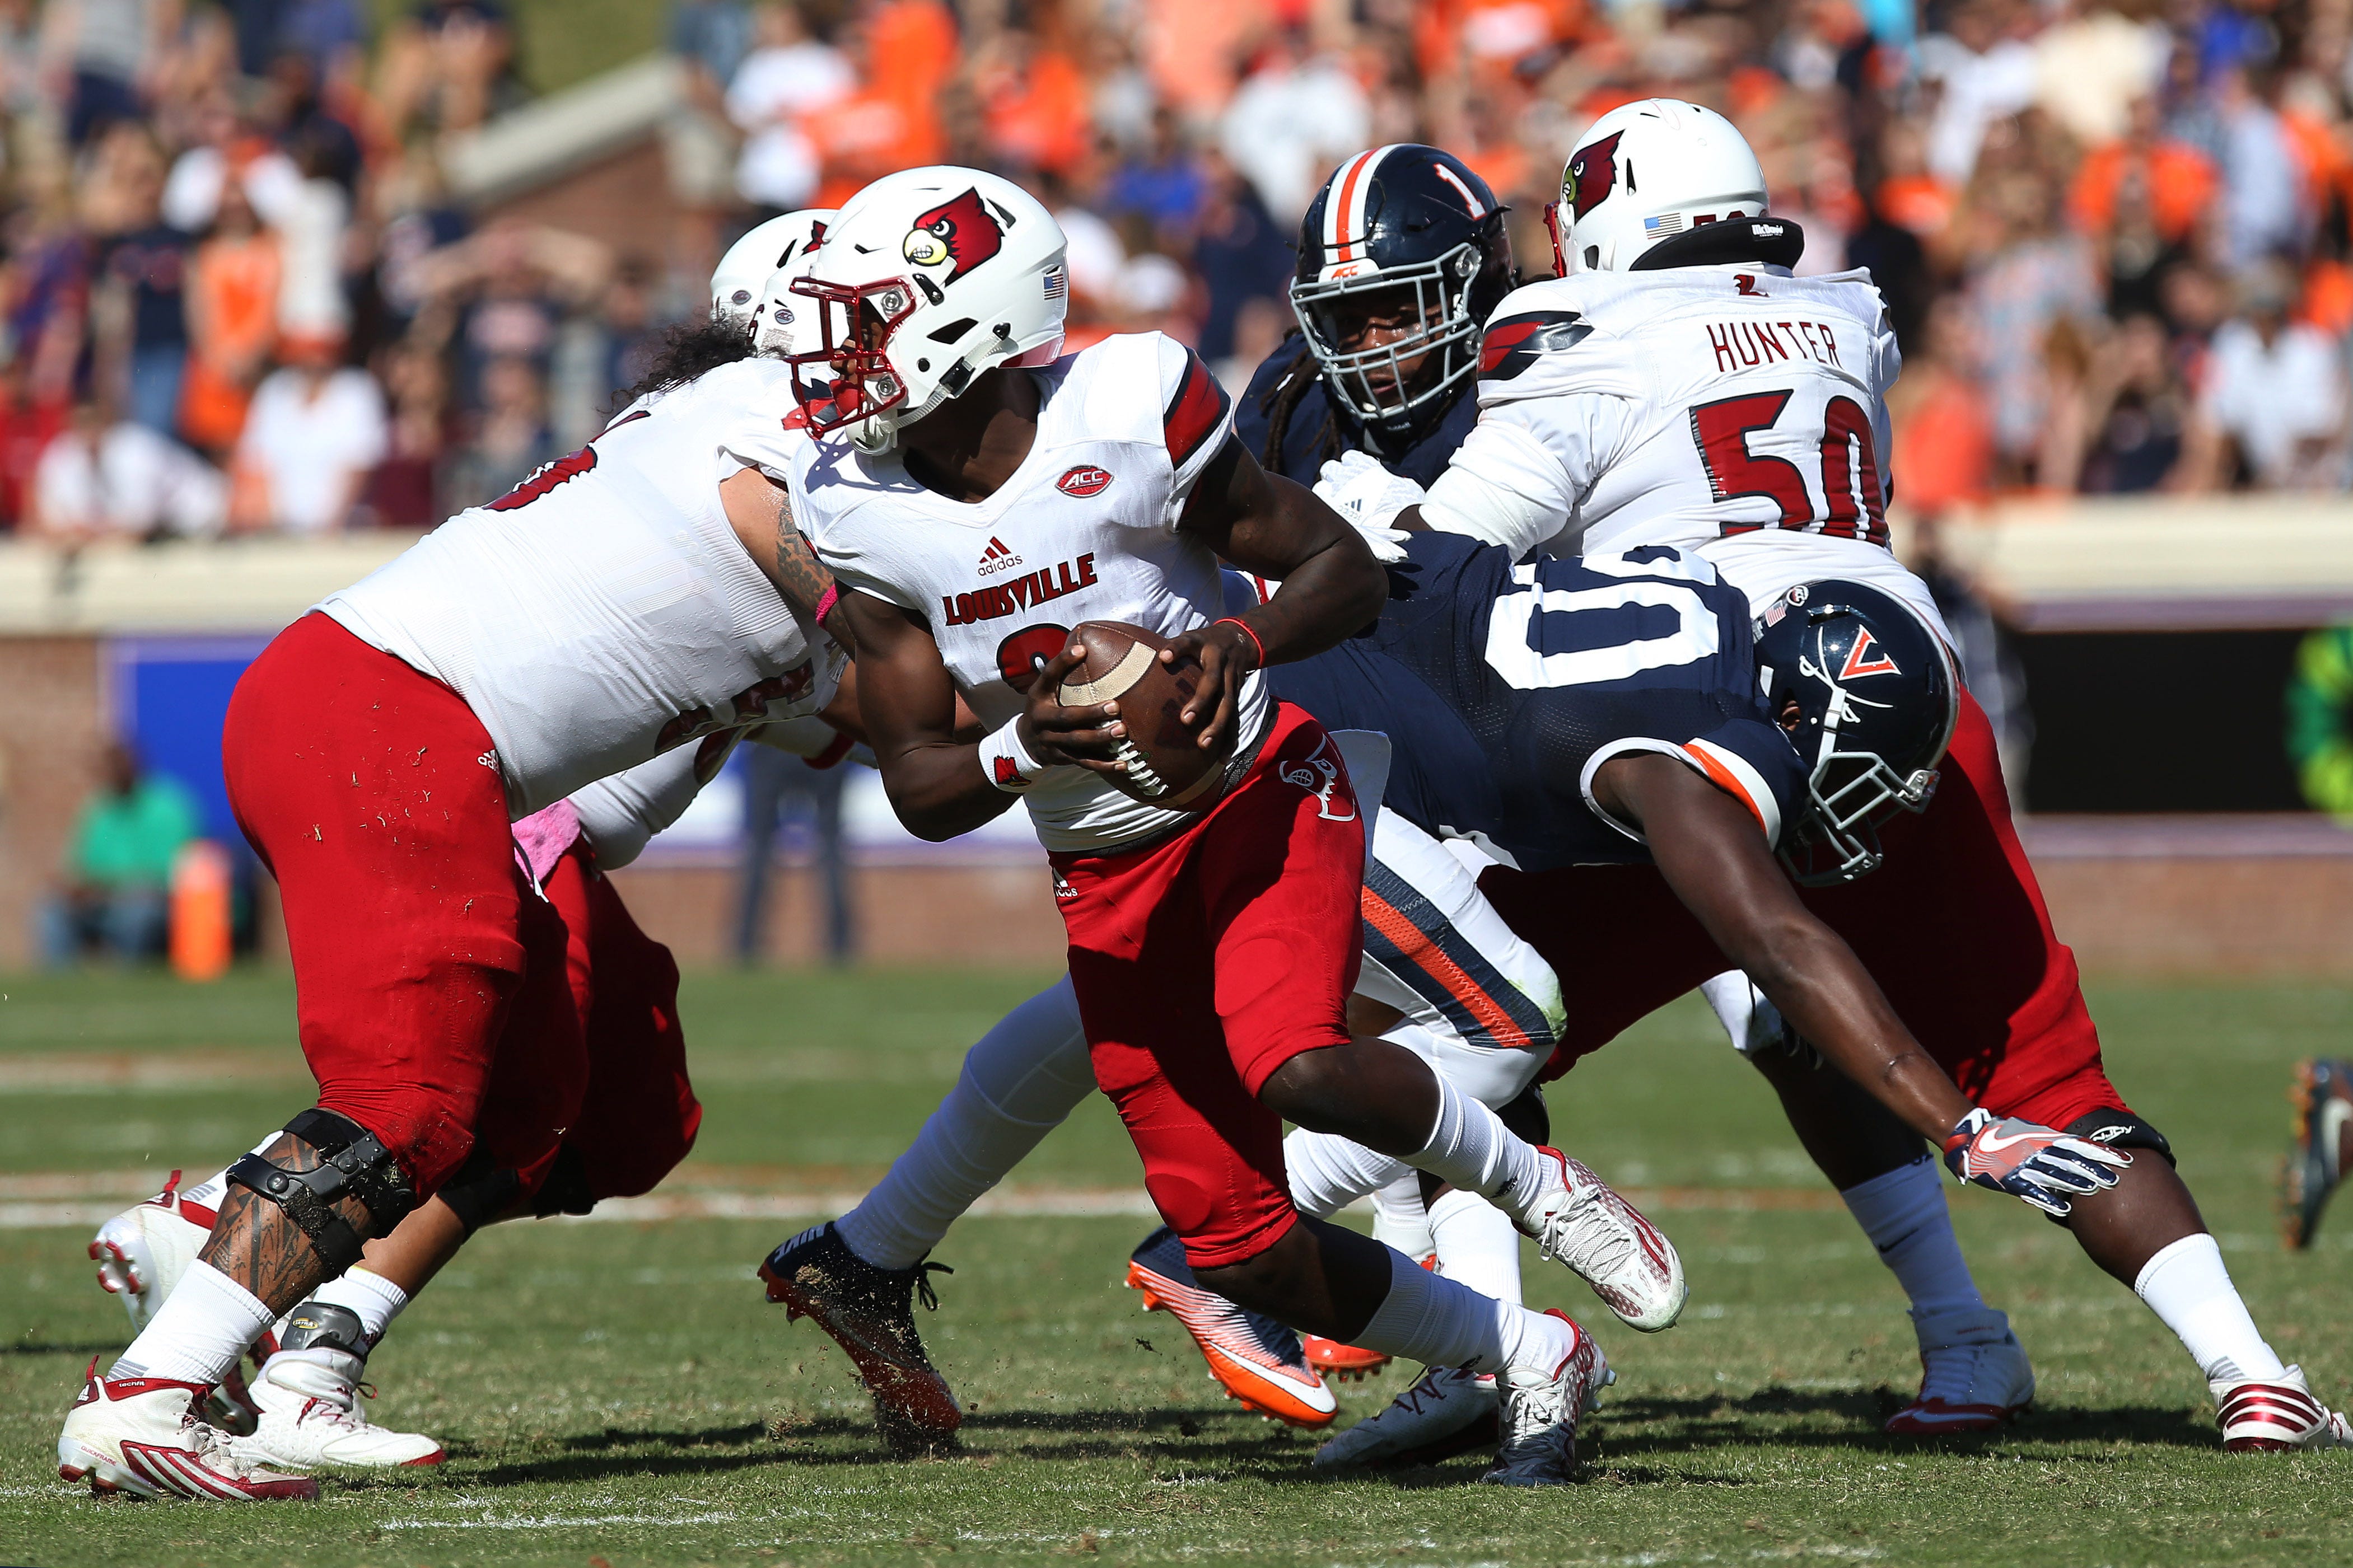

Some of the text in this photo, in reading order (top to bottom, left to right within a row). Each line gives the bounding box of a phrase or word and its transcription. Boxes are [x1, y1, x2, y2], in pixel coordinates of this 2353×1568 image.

[1433, 162, 1487, 221] 1
[1331, 265, 1358, 280] ACC
[1707, 321, 1845, 373] HUNTER
[1067, 470, 1104, 488] ACC
[1689, 389, 1892, 549] 50
[978, 555, 1023, 576] adidas
[943, 552, 1098, 626] LOUISVILLE
[80, 1445, 117, 1467] QUICKFRAME
